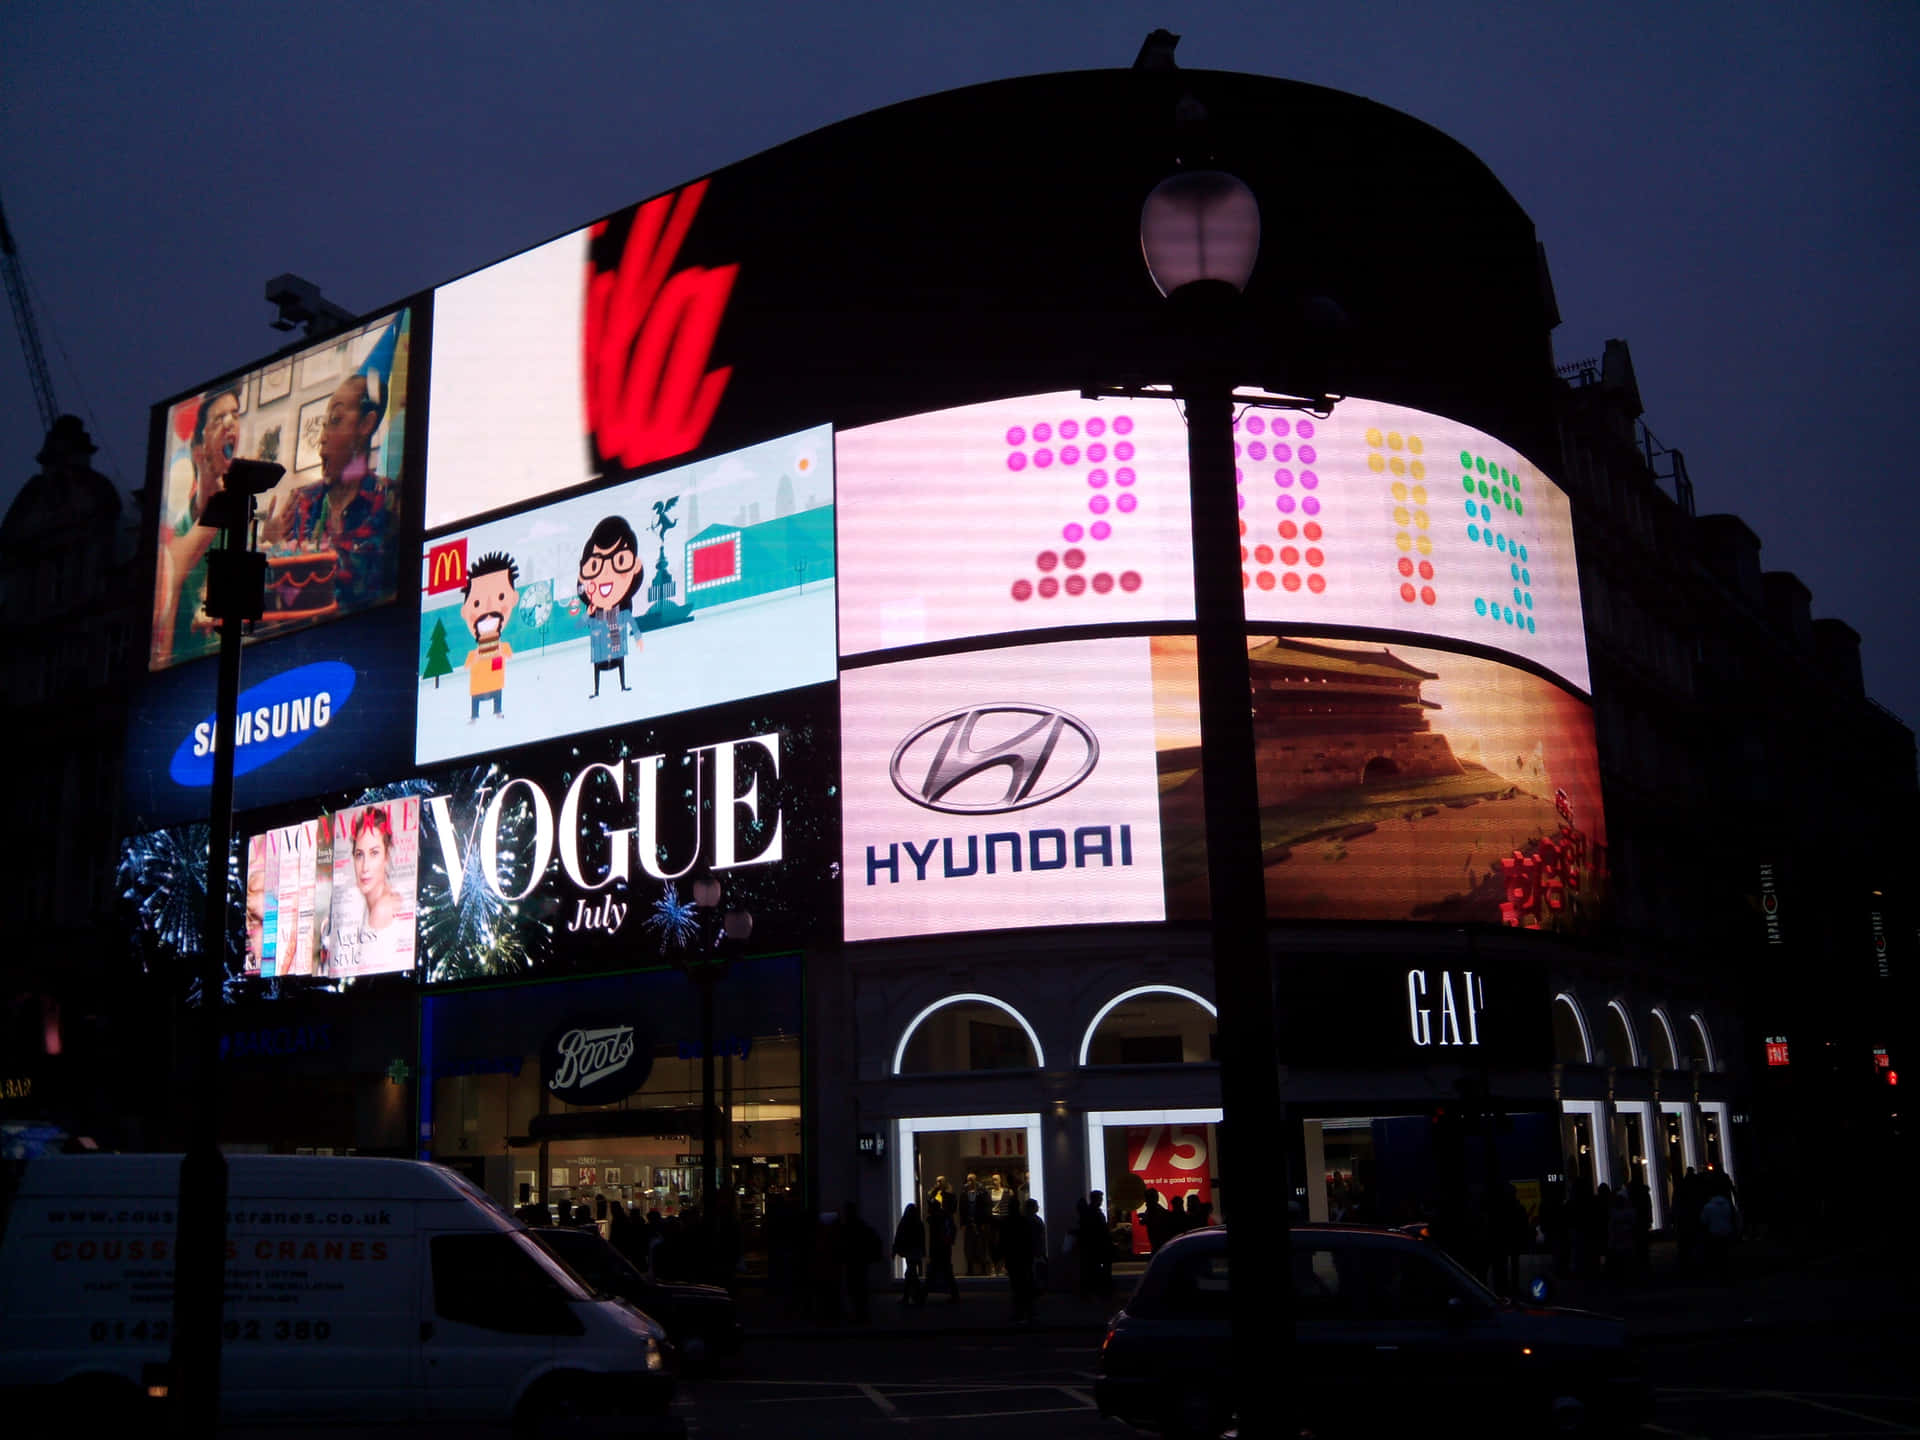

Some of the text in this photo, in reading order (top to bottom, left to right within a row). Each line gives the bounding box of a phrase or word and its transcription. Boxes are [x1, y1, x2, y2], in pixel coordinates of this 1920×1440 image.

[424, 732, 784, 908] VOGUE
[866, 824, 1133, 886] HYUNDAI
[567, 893, 629, 935] July
[548, 1023, 636, 1089] Boots
[52, 1239, 389, 1262] COUSSS CRANES
